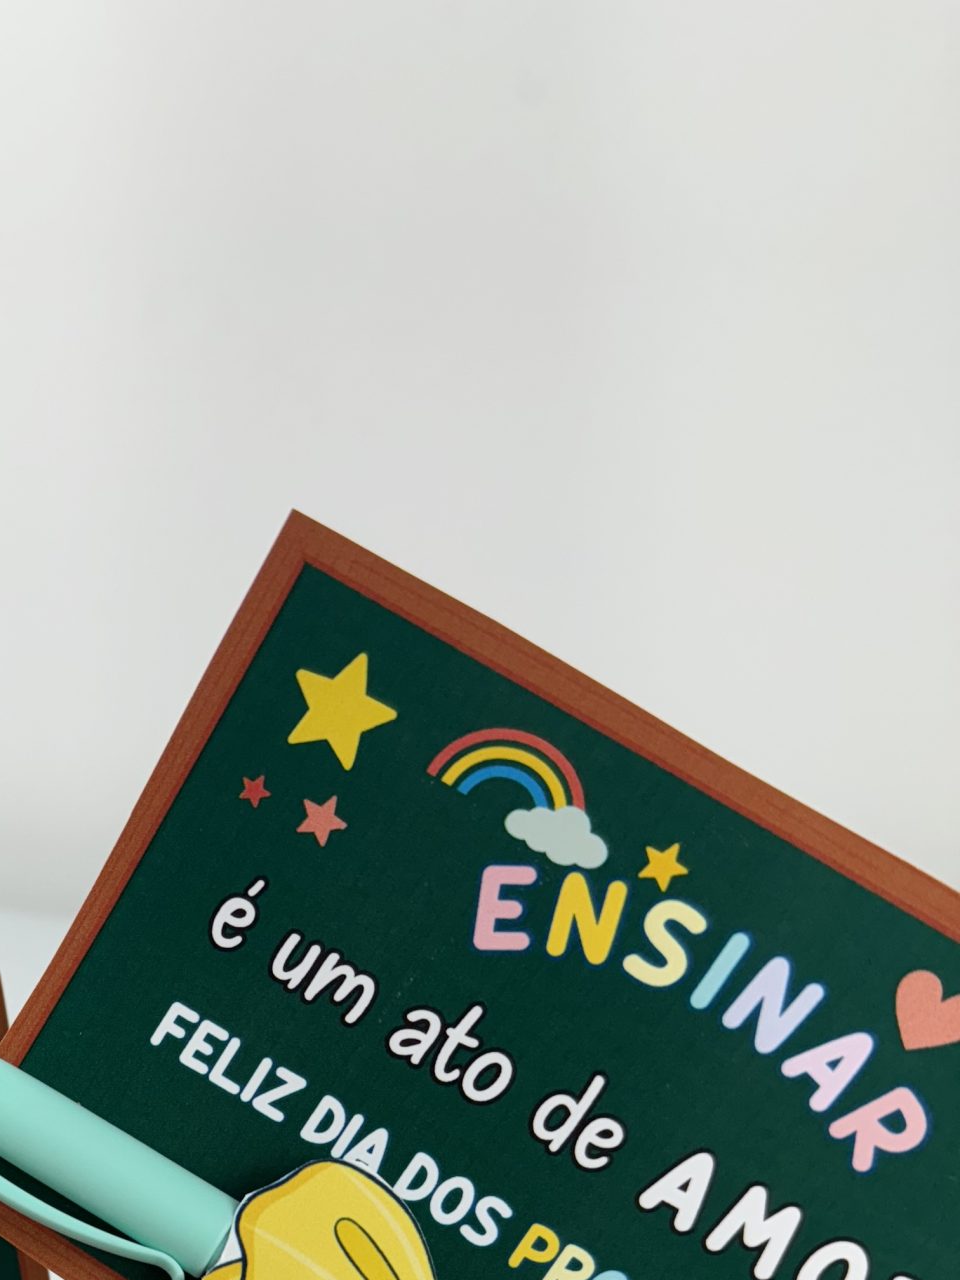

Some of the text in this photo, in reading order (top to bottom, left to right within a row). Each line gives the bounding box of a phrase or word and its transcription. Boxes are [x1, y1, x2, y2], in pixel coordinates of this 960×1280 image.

[149, 1001, 308, 1123] FELIZ
[299, 1094, 390, 1175] DIA
[392, 1151, 514, 1247] DOS
[211, 878, 267, 948] é
[270, 930, 377, 1025] um
[388, 1003, 515, 1102] ato
[531, 1075, 627, 1171] de
[472, 864, 930, 1174] ENSINAR
